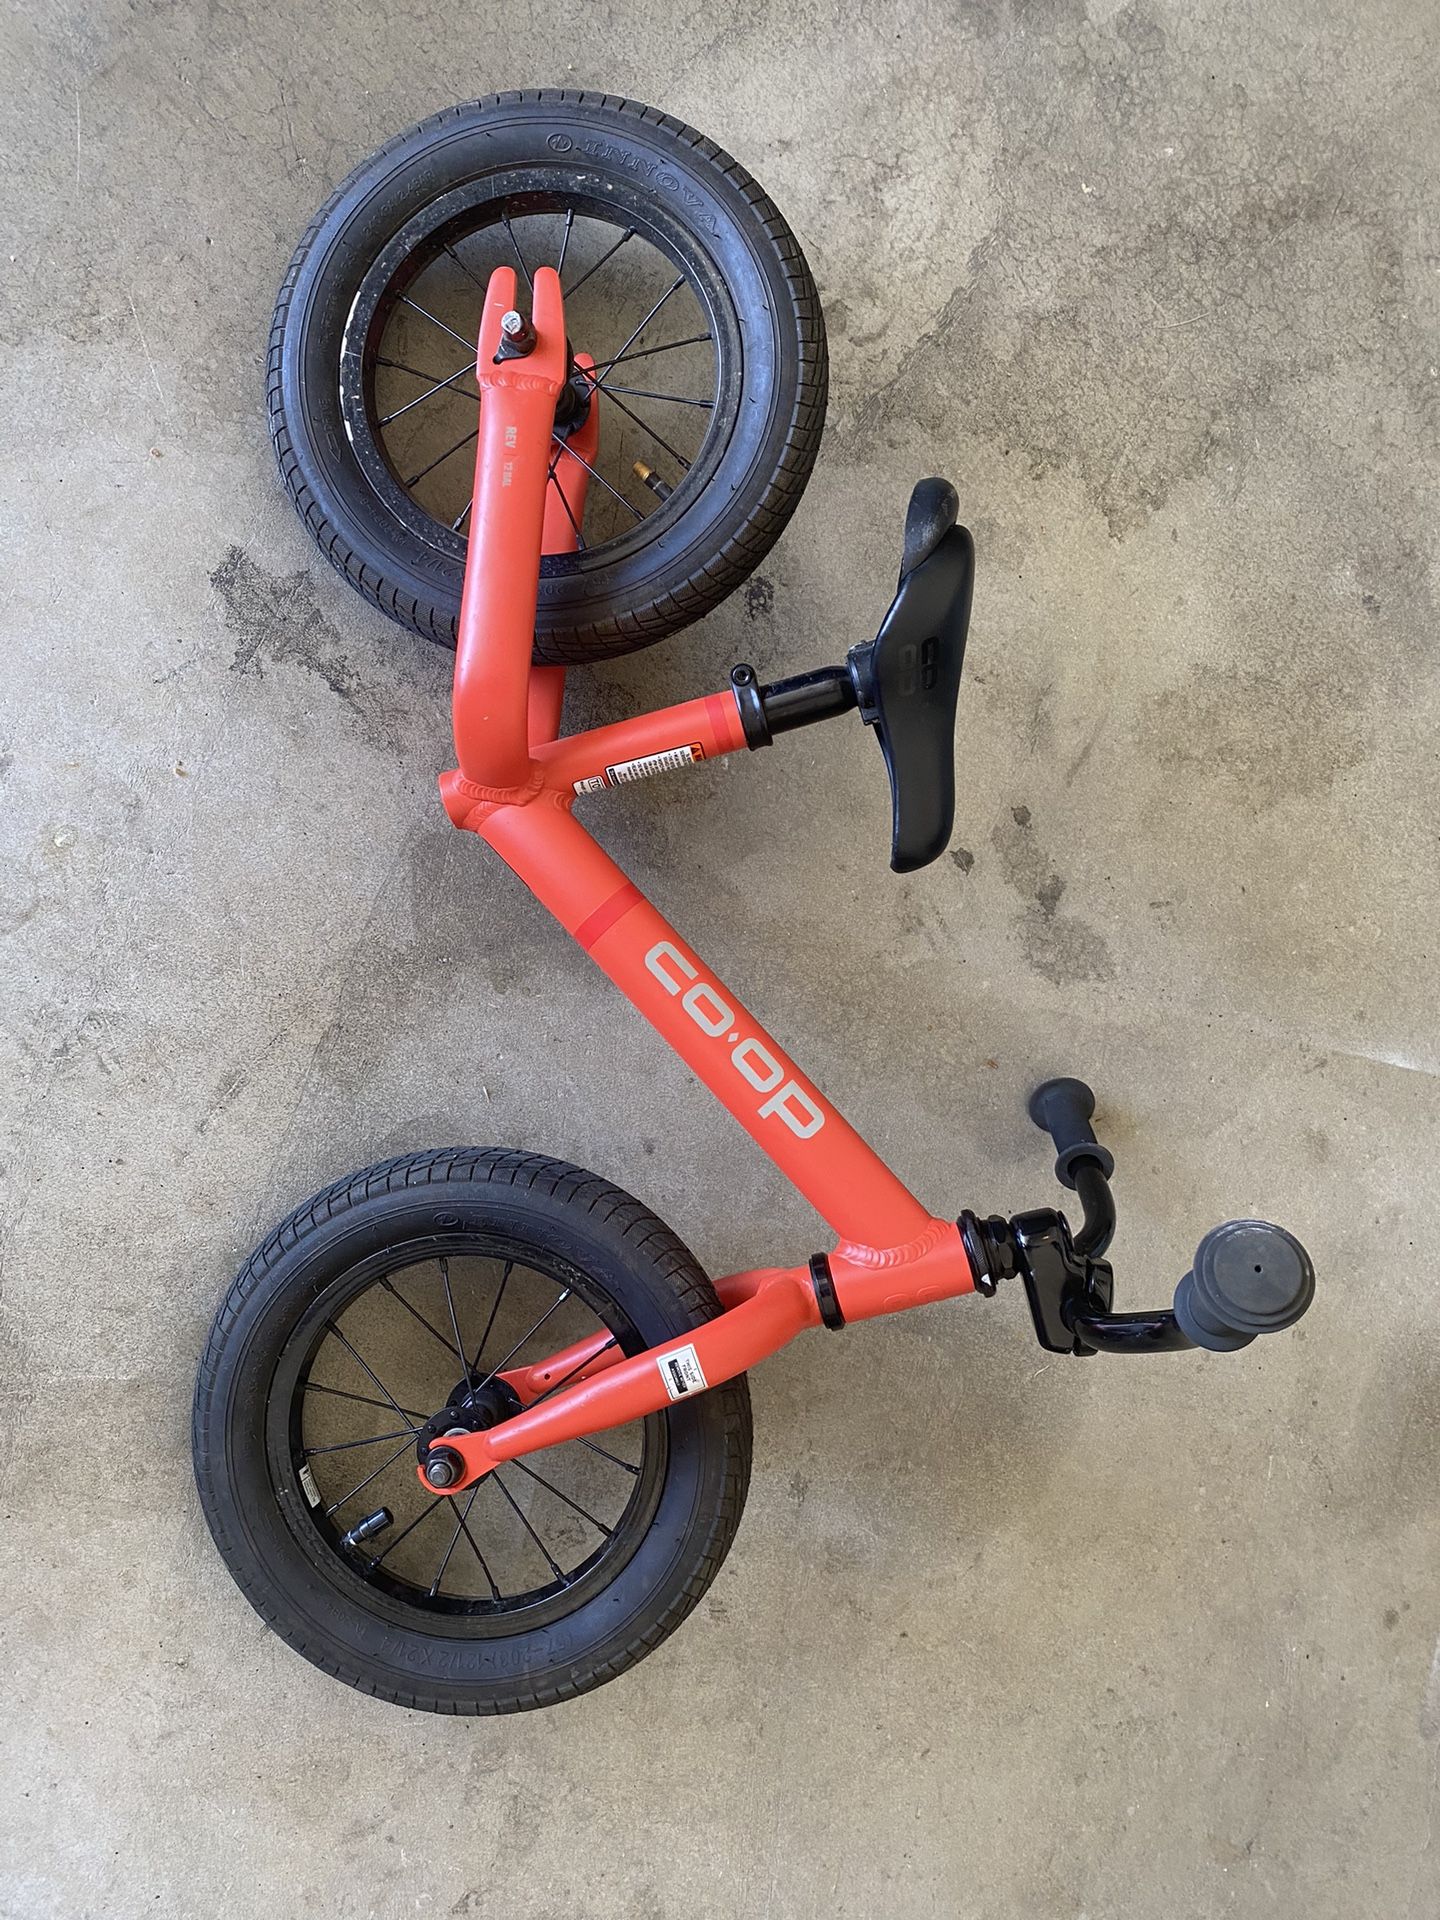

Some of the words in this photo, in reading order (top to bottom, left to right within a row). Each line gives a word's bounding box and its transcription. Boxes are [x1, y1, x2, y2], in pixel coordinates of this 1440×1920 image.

[581, 139, 722, 235] INNOVA
[504, 426, 517, 449] REV
[681, 1364, 690, 1381] FRONT
[684, 1358, 692, 1370] THIS
